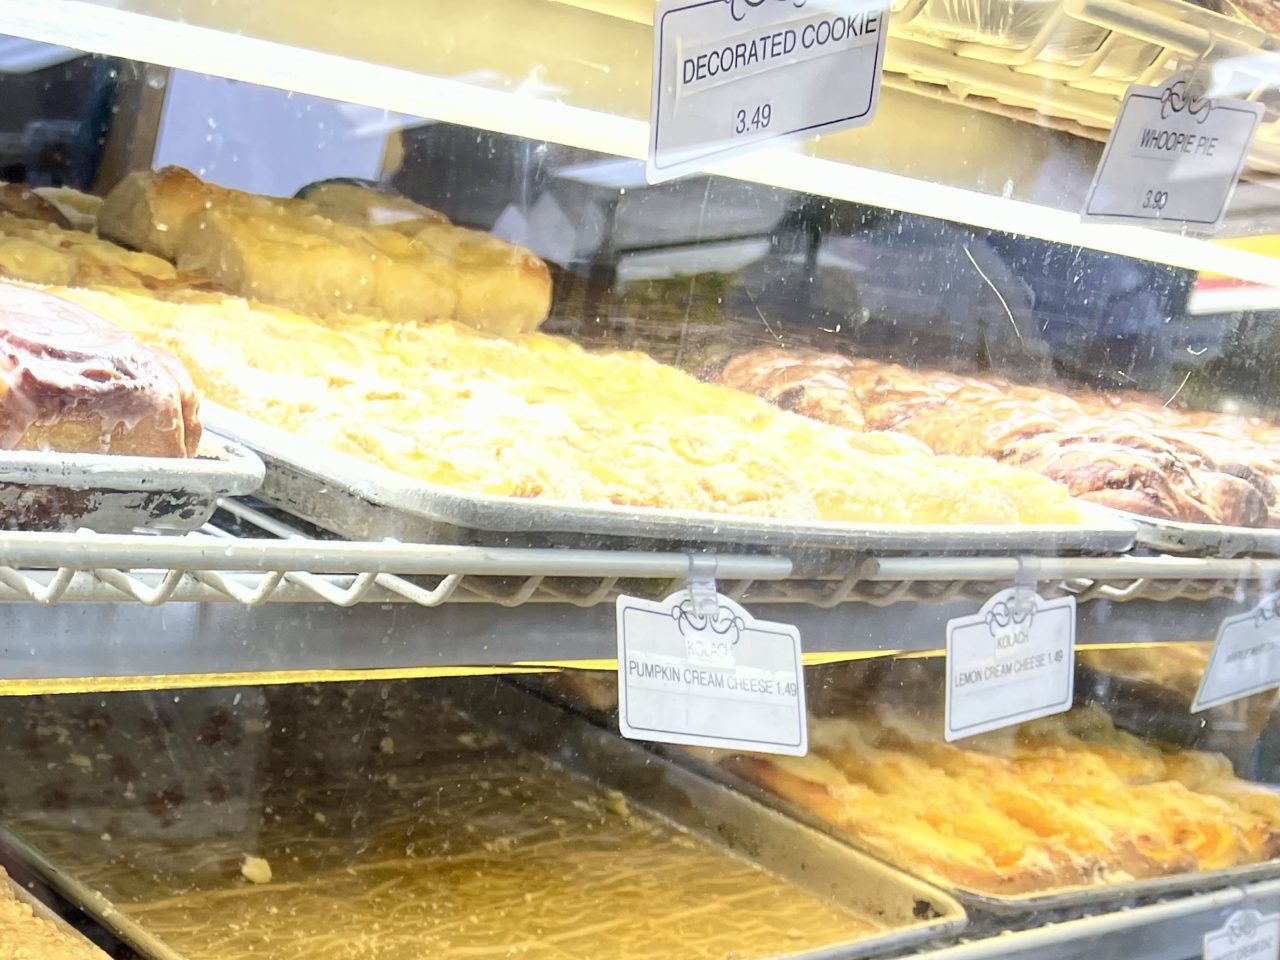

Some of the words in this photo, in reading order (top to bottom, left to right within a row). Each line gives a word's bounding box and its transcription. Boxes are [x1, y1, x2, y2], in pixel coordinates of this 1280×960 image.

[683, 30, 796, 84] DECORATED
[802, 13, 878, 49] COOKIE
[736, 103, 772, 134] 3.49
[1140, 128, 1196, 153] WHOOPIE
[1196, 136, 1219, 156] PIE
[629, 660, 680, 683] PUMPKIN
[683, 668, 724, 689] CREAM
[726, 675, 773, 695] CHEESE
[776, 681, 798, 697] 1.49
[954, 670, 982, 688] LEMON
[984, 663, 1013, 681] CREAM
[1013, 653, 1046, 673] CHEESE
